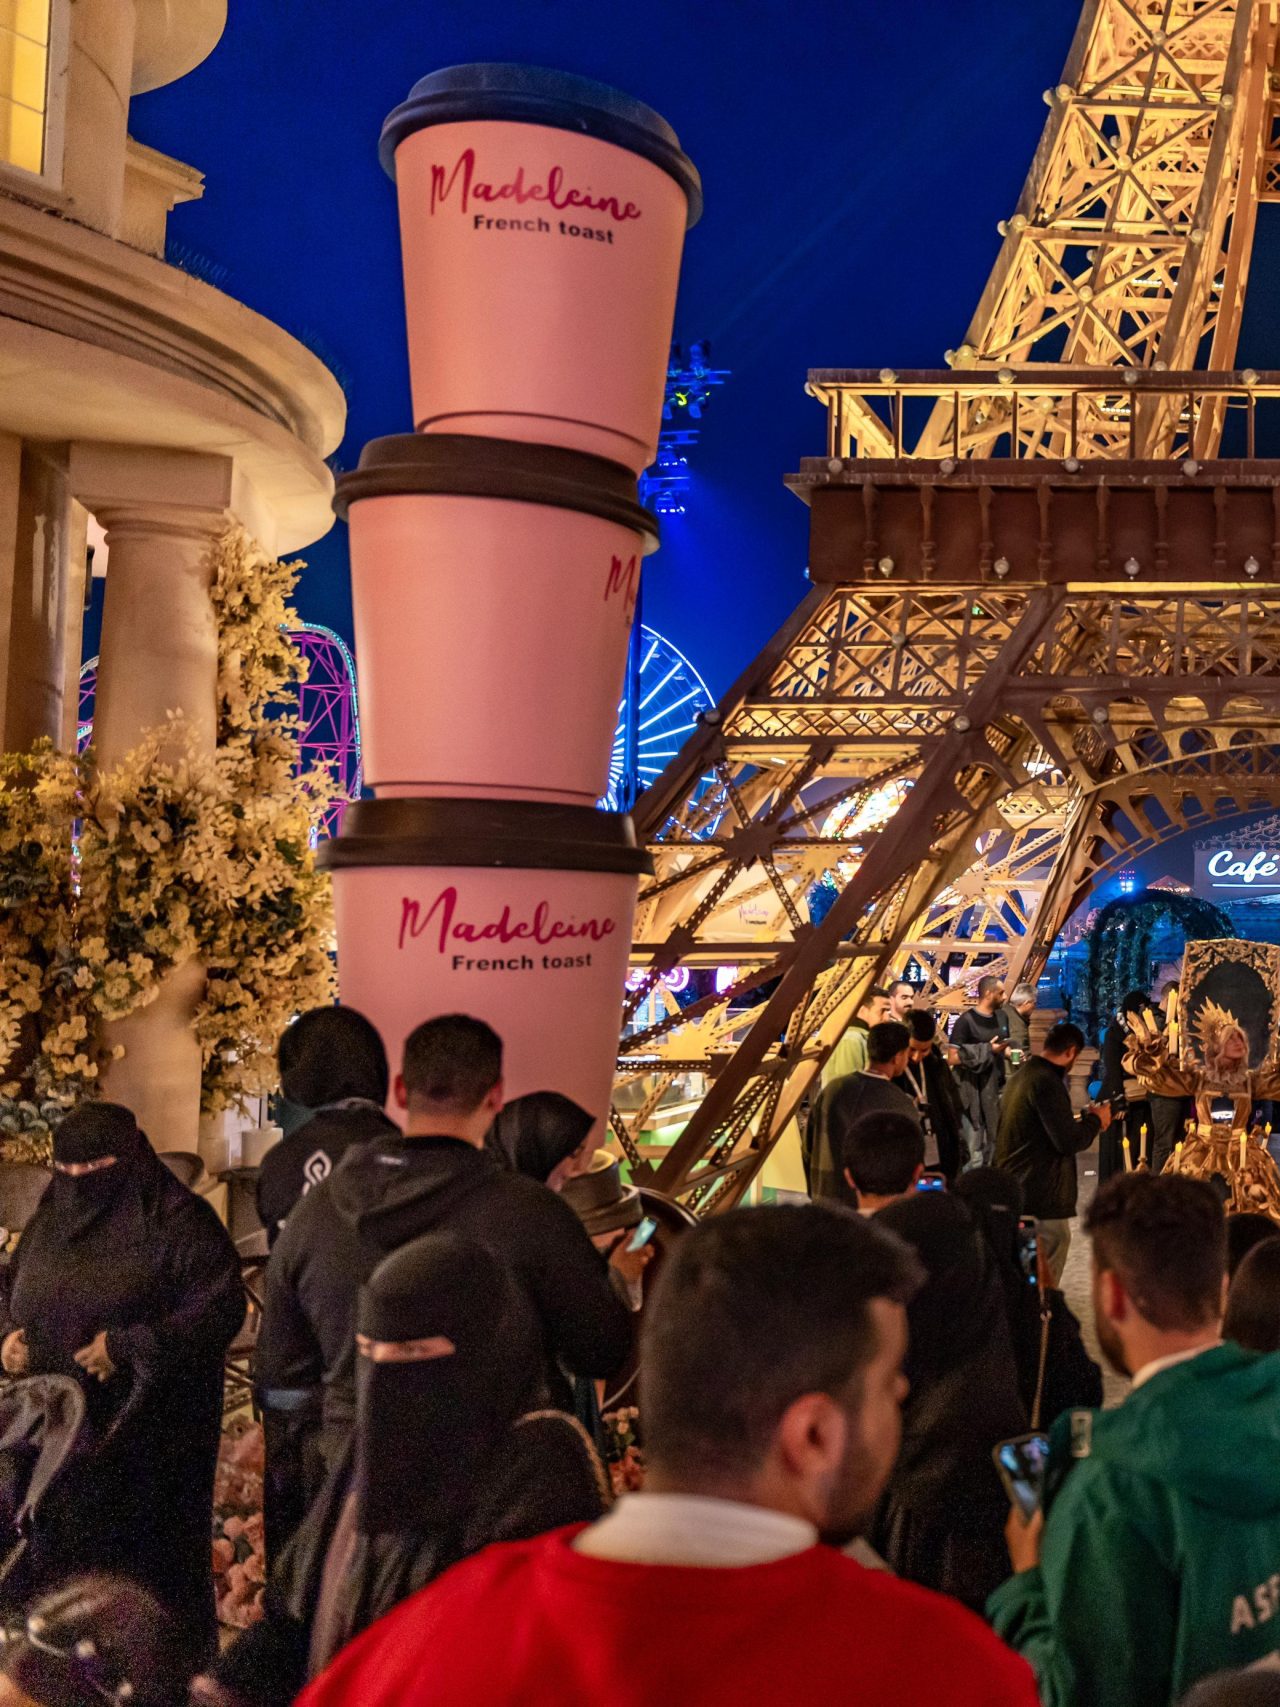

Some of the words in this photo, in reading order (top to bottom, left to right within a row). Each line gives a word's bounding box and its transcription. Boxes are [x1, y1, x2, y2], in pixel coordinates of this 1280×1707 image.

[430, 148, 641, 221] Madeleine
[473, 214, 550, 233] French
[559, 221, 614, 244] toast
[1208, 850, 1279, 883] Café
[398, 886, 616, 954] Madeleine
[452, 955, 533, 971] French
[542, 953, 592, 970] toast
